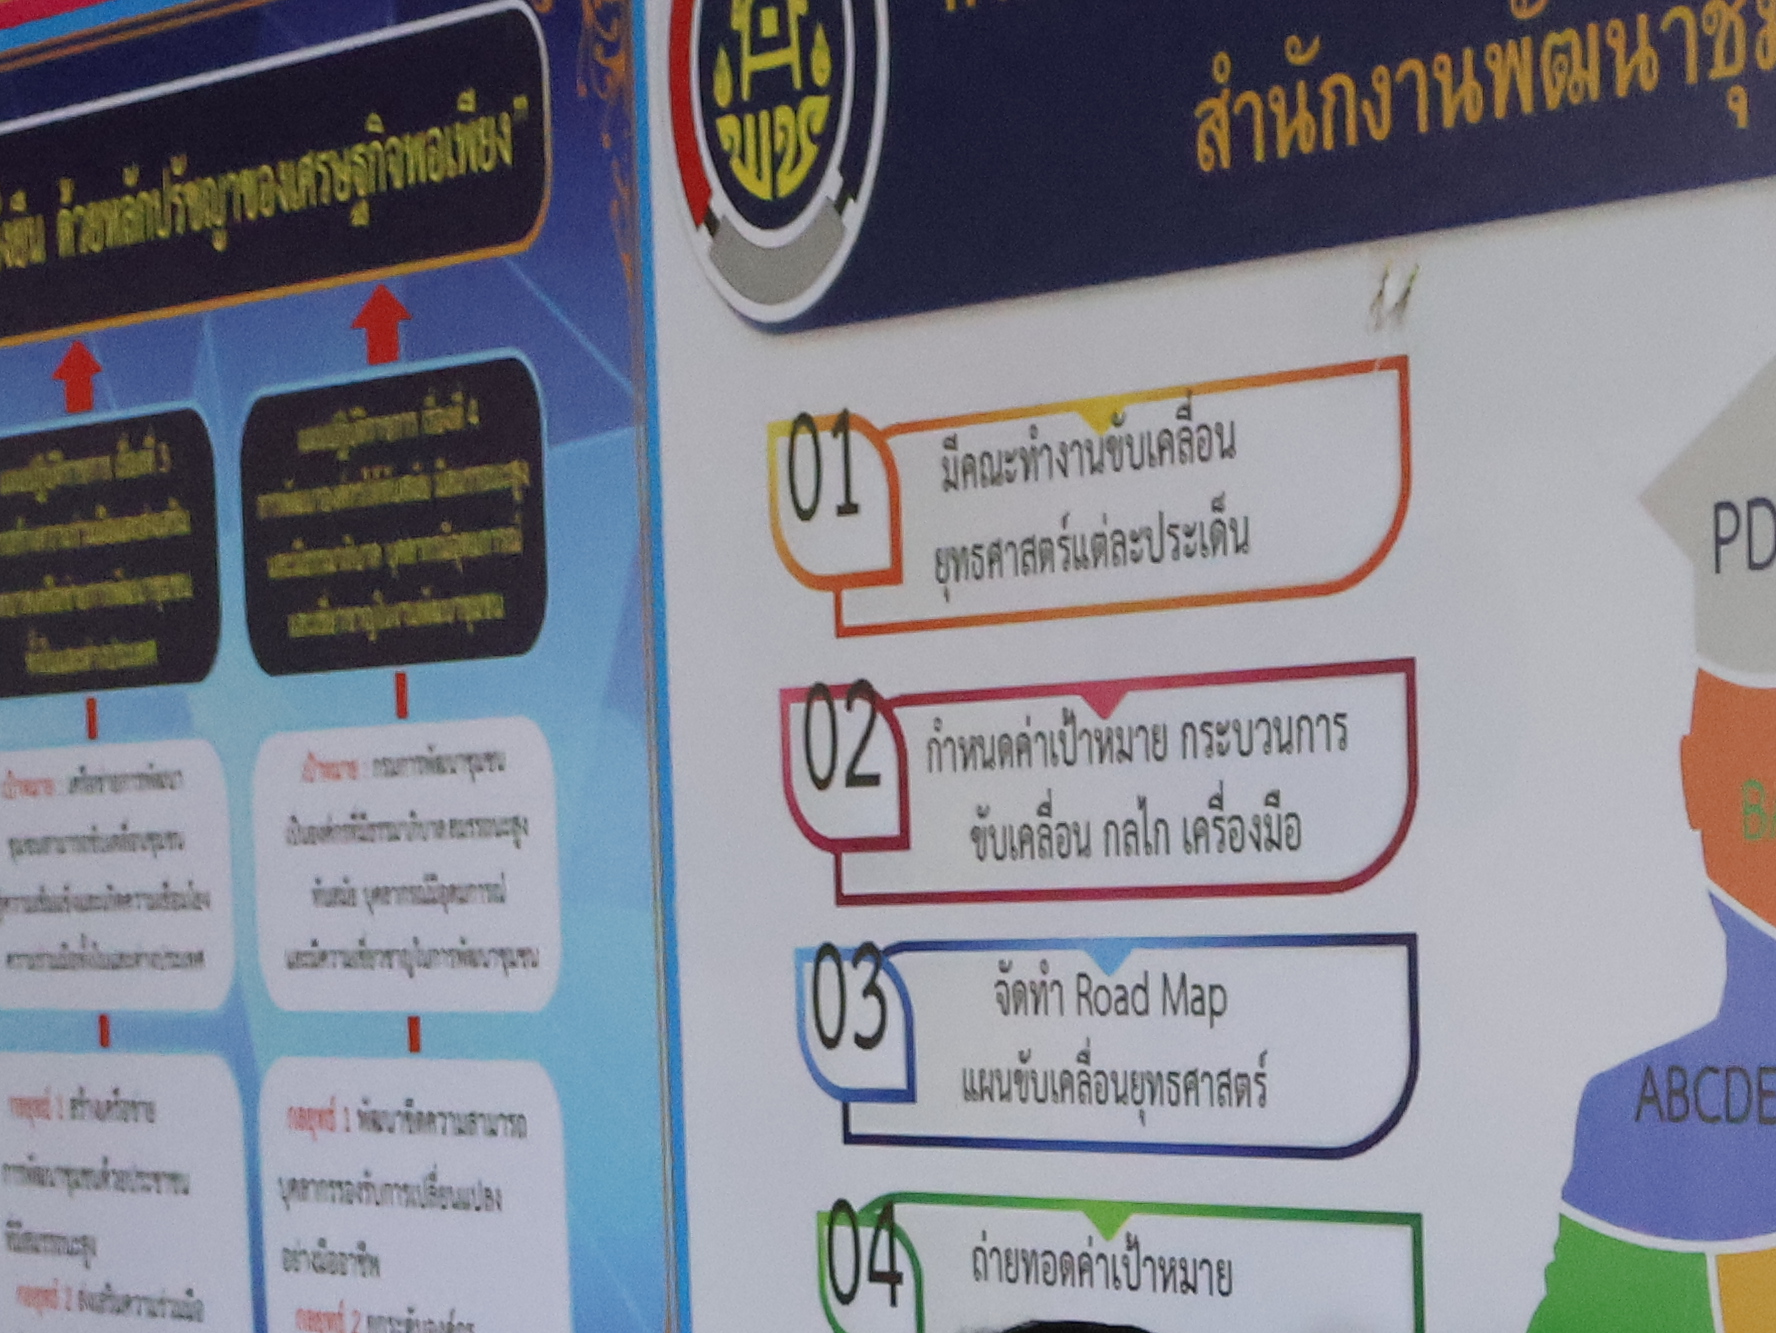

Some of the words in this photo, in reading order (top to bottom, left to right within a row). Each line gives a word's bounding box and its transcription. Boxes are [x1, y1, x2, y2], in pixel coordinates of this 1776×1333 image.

[786, 408, 860, 523] 01
[940, 391, 1237, 495] มีคณะทำงานขับเคลื่อน
[933, 493, 1251, 603] ยุทธศาสตร์แต่ละประเด็น
[803, 679, 881, 791] 02
[926, 707, 1169, 775] กำหนดค่าเป้าหมาย
[1180, 710, 1350, 760] กระบวนการ
[969, 789, 1092, 863] ขับเคลื่อน
[1103, 796, 1171, 859] กลไก
[1182, 780, 1303, 857] เครื่องมือ
[812, 942, 887, 1050] 03
[994, 960, 1065, 1018] จัดทำ
[1076, 971, 1150, 1019] Road
[1161, 977, 1228, 1029] Map
[961, 1038, 1269, 1125] แผนขับเคลื่อนยุทธศาสตร์
[826, 1198, 905, 1307] 04
[971, 1230, 1234, 1299] ถ่ายทอดค่าเป้าหมาย
